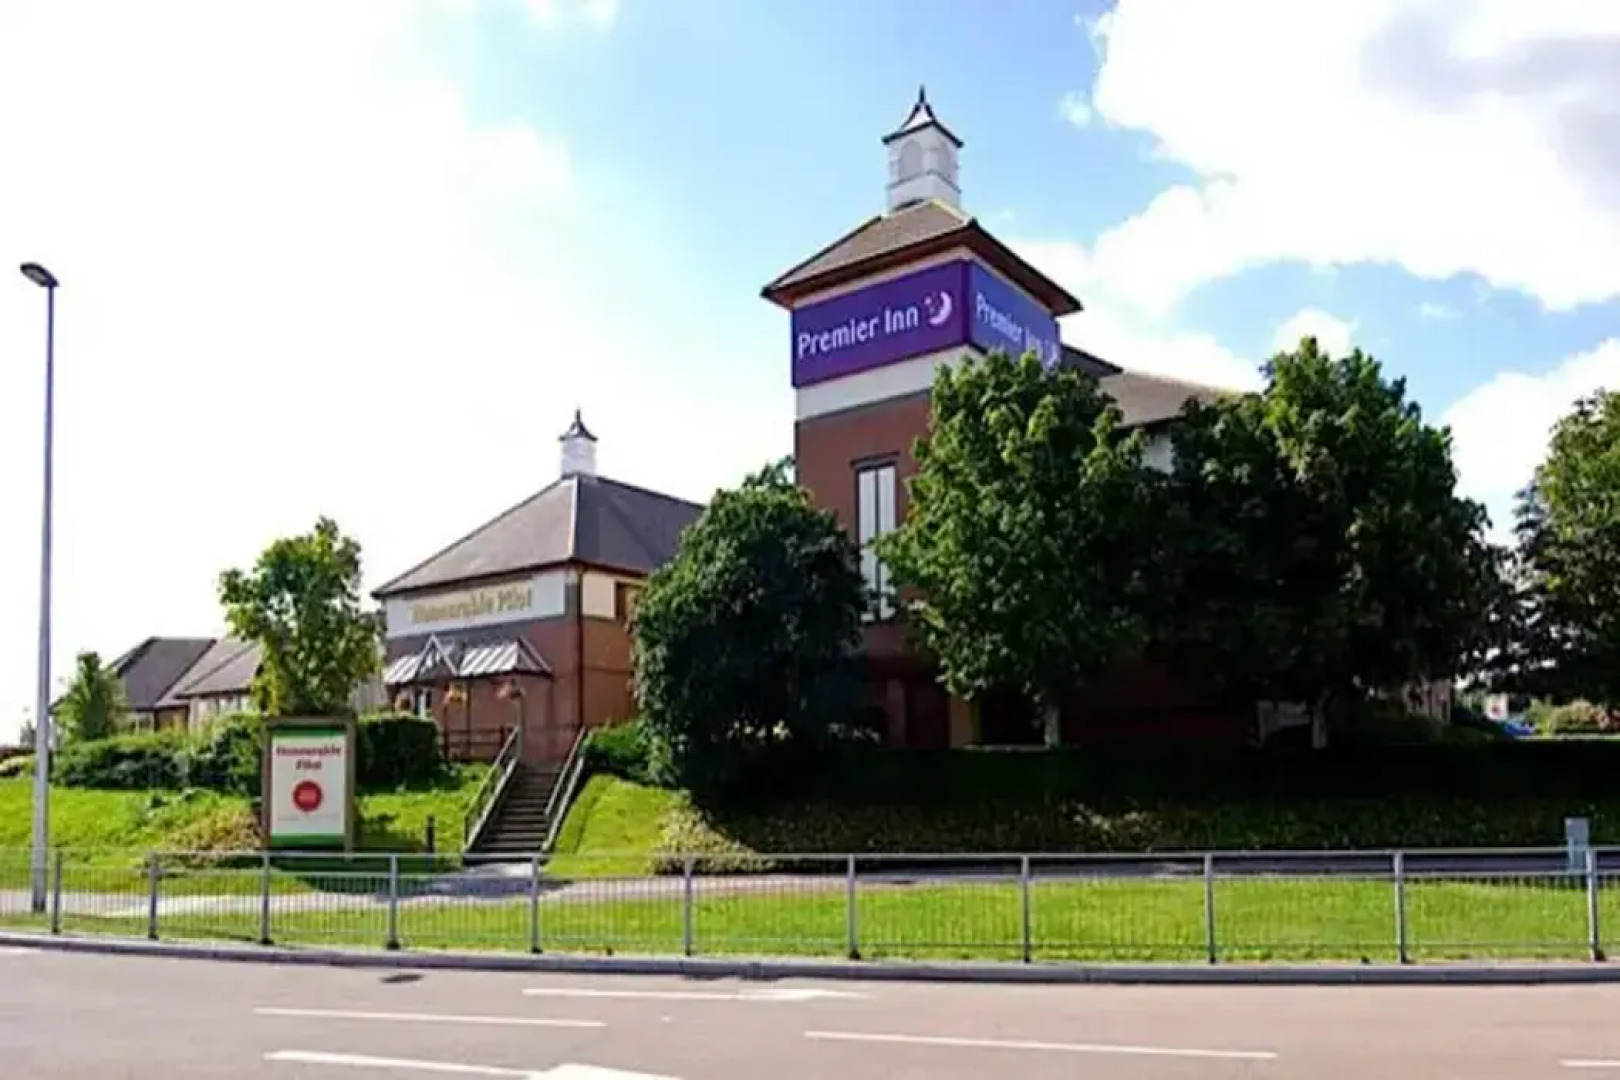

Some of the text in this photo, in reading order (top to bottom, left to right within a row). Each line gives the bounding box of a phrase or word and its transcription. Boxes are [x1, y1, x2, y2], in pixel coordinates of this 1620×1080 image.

[798, 307, 918, 358] Premier Inn
[976, 292, 1022, 342] Premier
